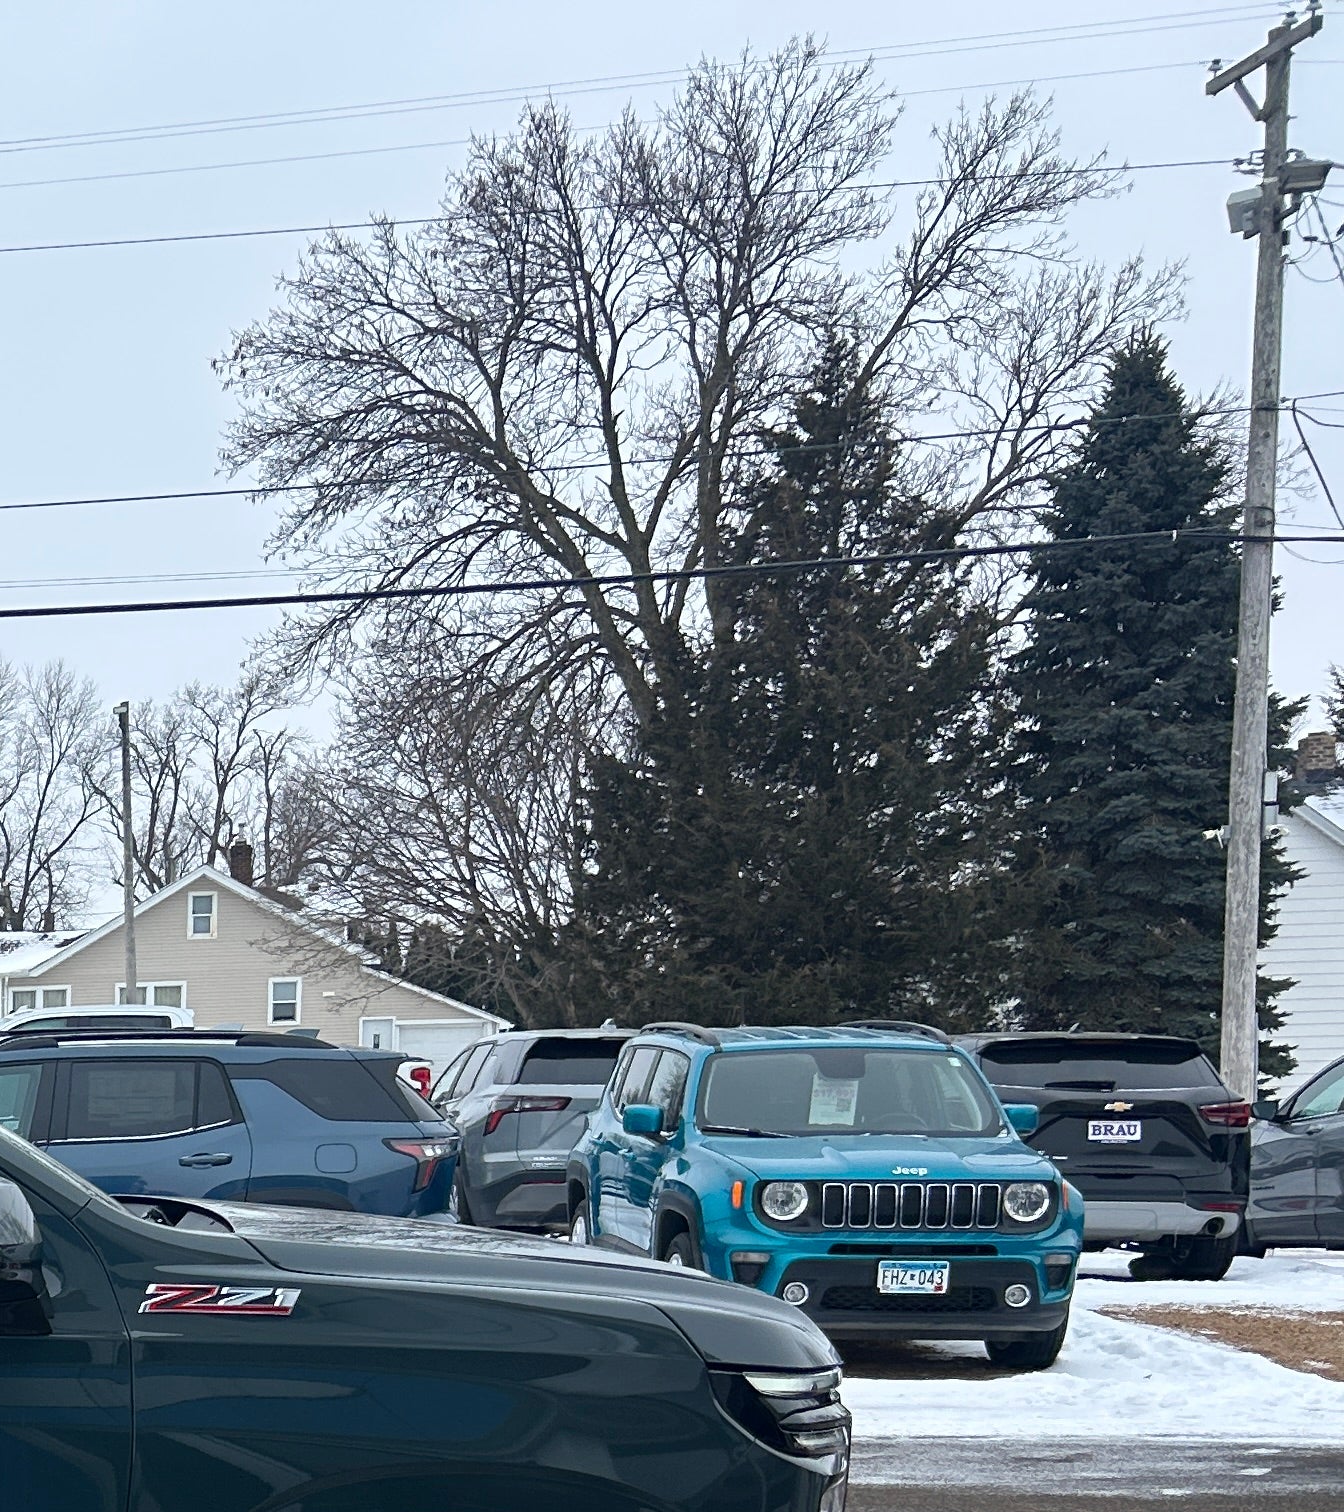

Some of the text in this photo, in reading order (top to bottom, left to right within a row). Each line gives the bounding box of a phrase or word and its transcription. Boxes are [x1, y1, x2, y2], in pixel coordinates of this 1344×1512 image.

[1091, 1124, 1138, 1136] BRAU
[892, 1166, 928, 1176] Jeep
[881, 1269, 944, 1286] FHZ 043
[137, 1283, 302, 1316] Z71
